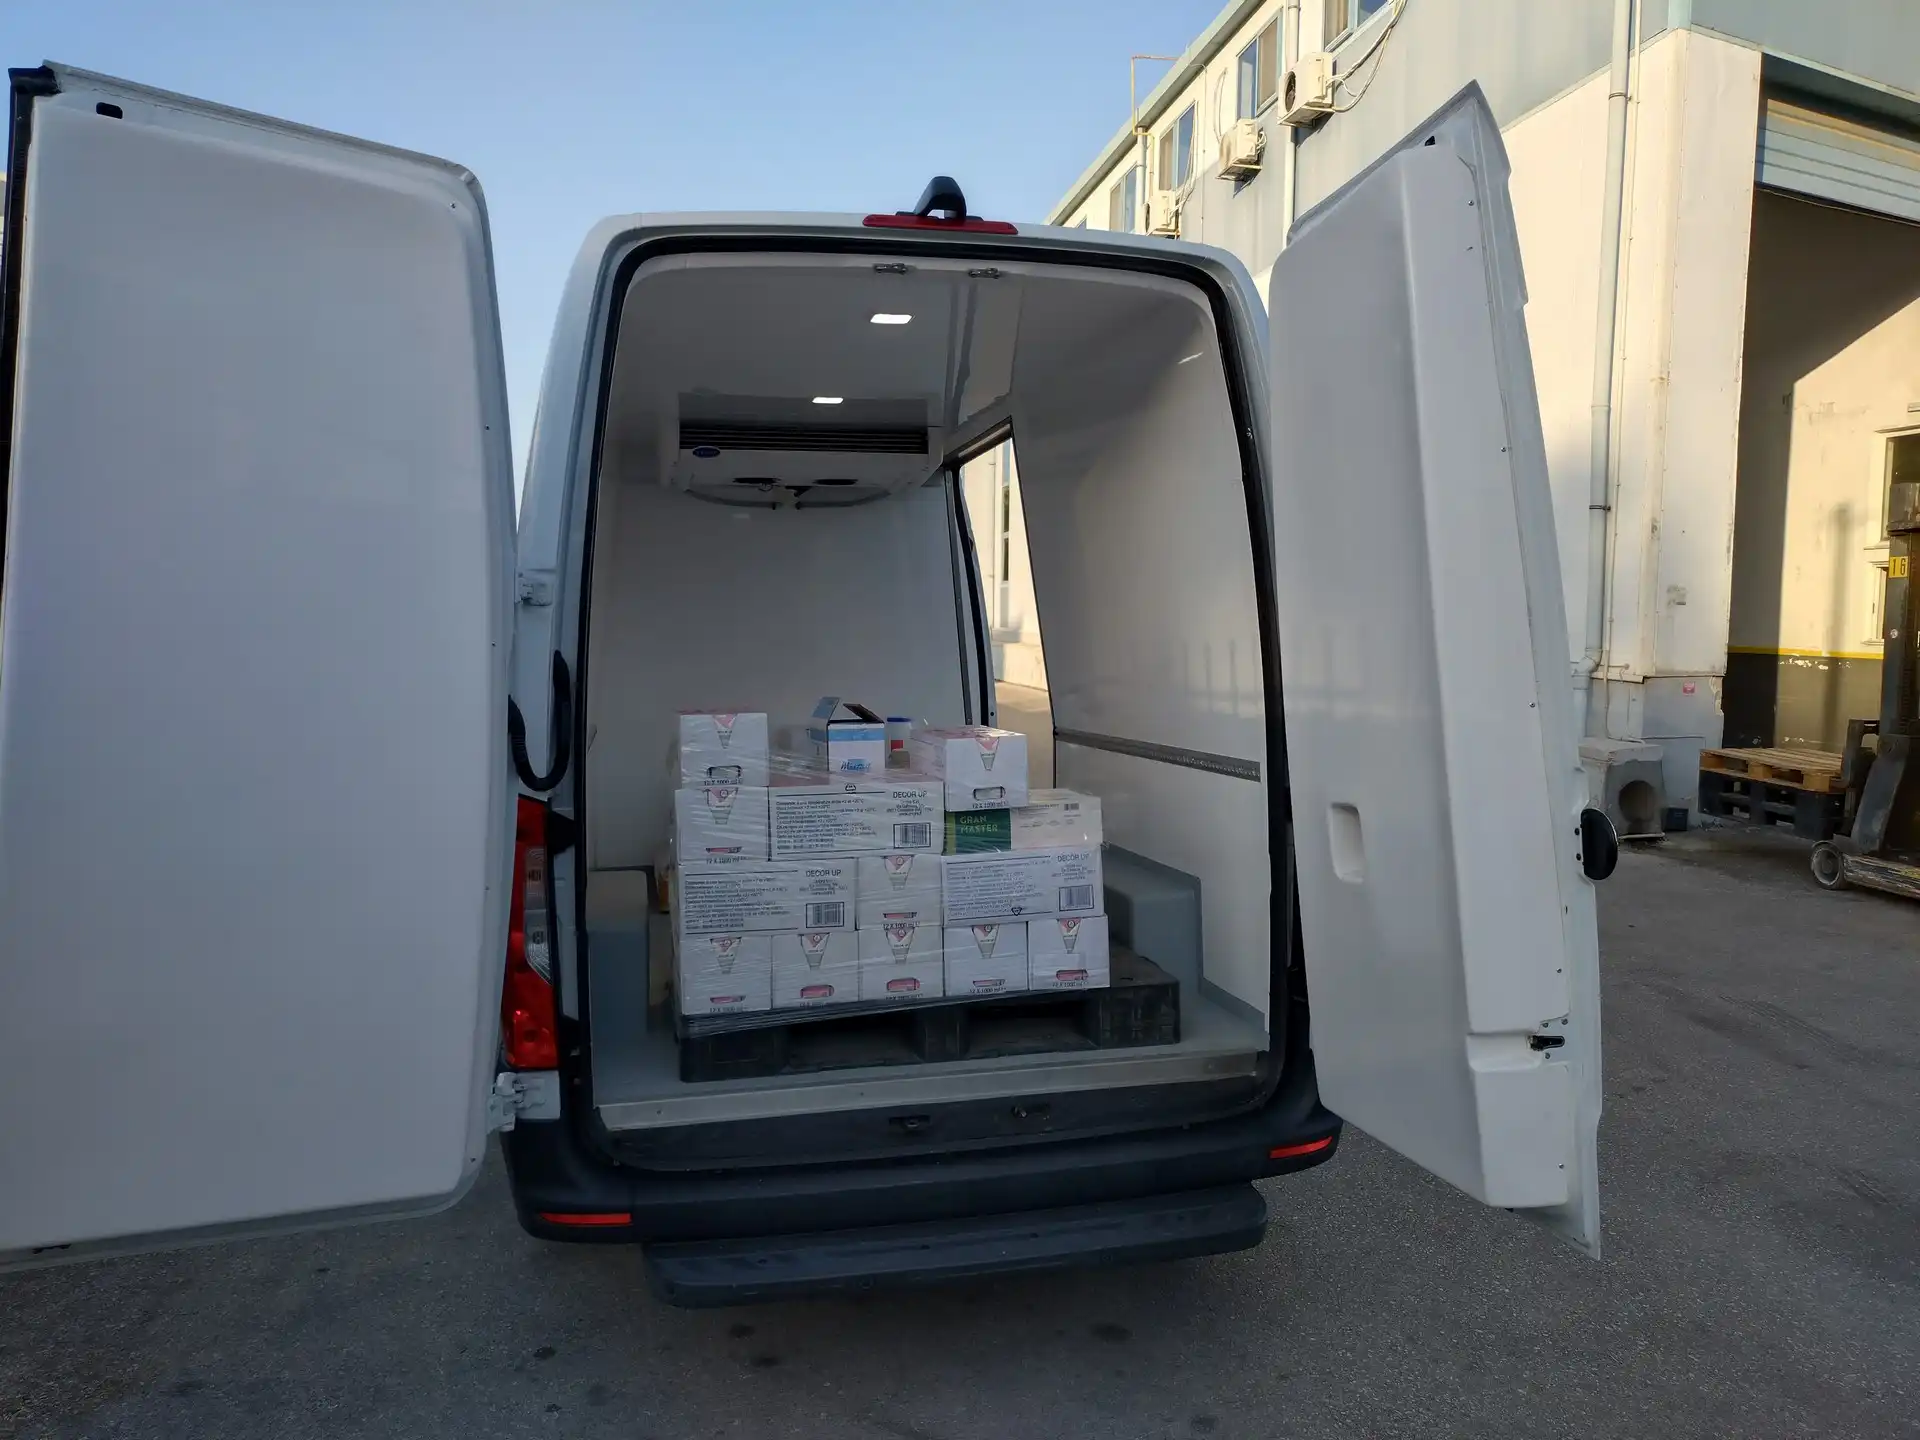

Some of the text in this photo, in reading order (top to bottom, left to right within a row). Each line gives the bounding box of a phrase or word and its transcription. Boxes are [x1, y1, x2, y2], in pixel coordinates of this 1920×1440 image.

[1892, 558, 1906, 576] 16
[892, 790, 927, 798] DECOR UP
[959, 815, 987, 824] GRAN
[960, 824, 998, 833] MASTER
[1057, 854, 1079, 862] DECOR
[805, 869, 830, 877] DECOR
